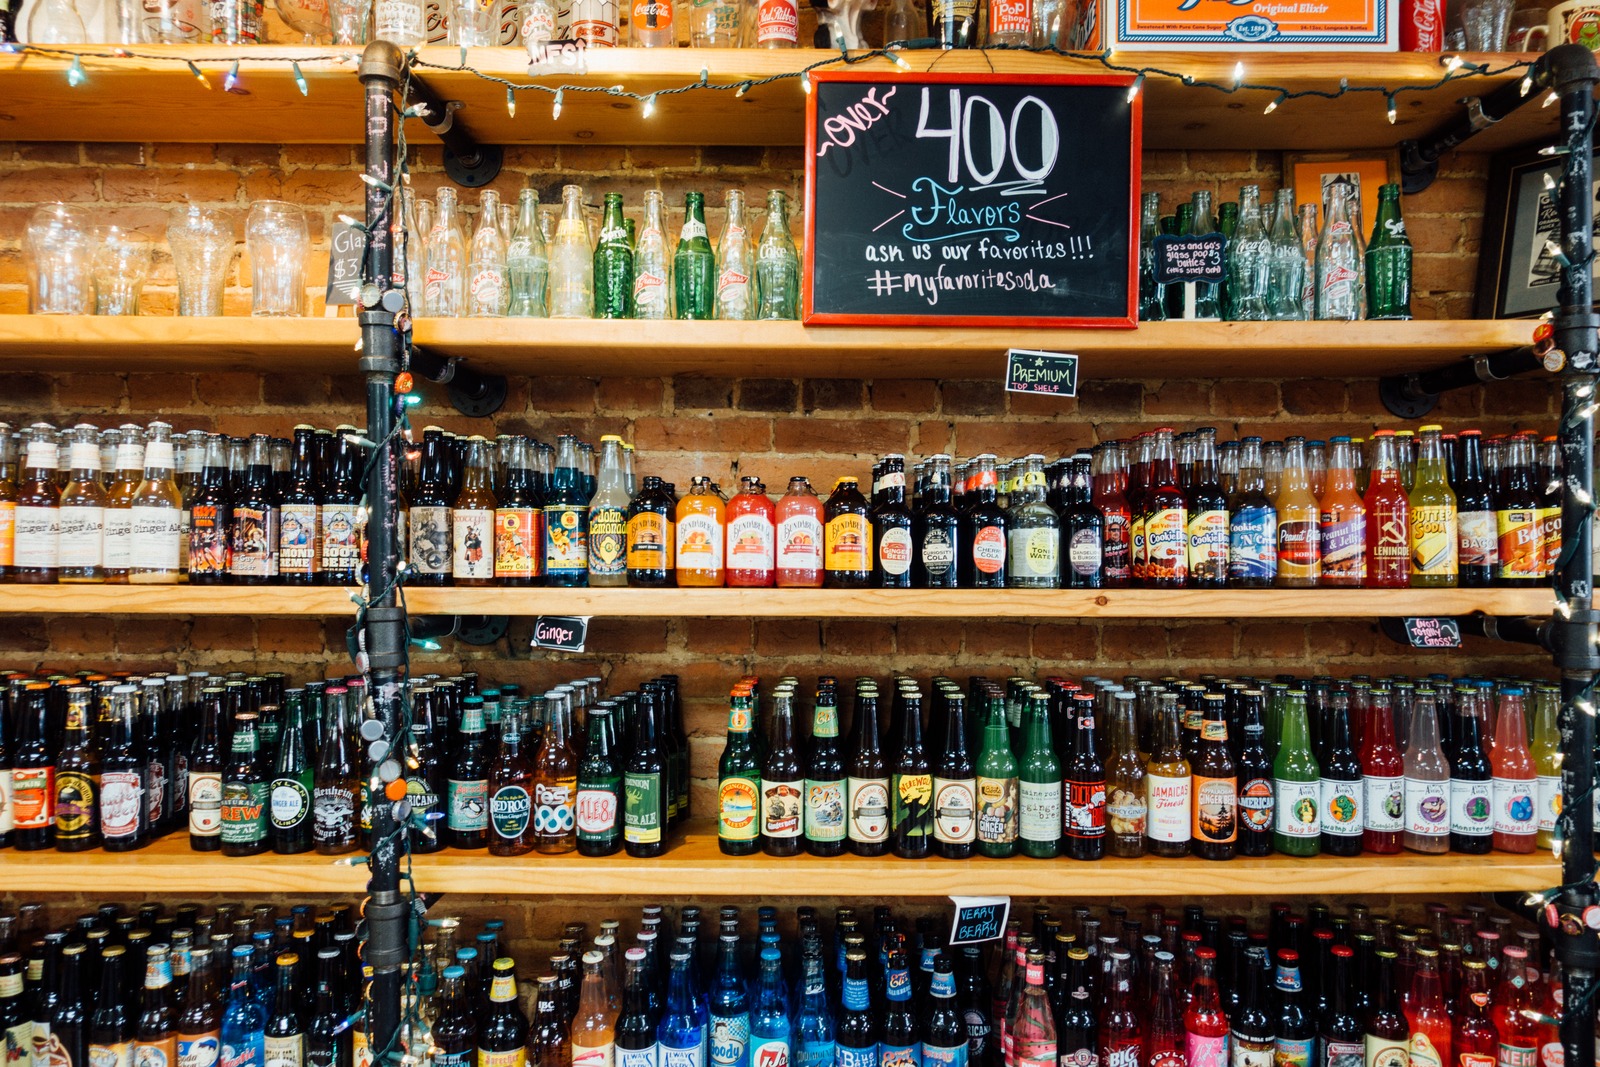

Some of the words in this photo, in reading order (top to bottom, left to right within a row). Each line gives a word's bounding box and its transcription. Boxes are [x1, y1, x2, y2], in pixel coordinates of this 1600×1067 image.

[633, 2, 670, 17] Coca-Cola
[1252, 4, 1298, 15] Original
[1299, 3, 1329, 13] Elixir
[915, 87, 1060, 184] 400
[911, 177, 1021, 225] Flavors
[600, 227, 627, 243] Sprite
[760, 244, 787, 260] Coke
[865, 242, 904, 262] ask
[912, 243, 932, 261] us
[942, 245, 970, 261] our
[979, 236, 1094, 261] favorites!!!
[1166, 243, 1186, 251] 50's
[1203, 242, 1220, 250] 60's
[1166, 251, 1190, 262] glass
[1192, 250, 1208, 260] pop
[1012, 362, 1072, 387] PREMIUM
[1011, 382, 1028, 390] TOP
[597, 509, 622, 523] John
[1411, 509, 1453, 525] BUTTER
[49, 522, 60, 532] Al
[86, 522, 103, 531] Ale
[105, 527, 131, 536] Ginge
[134, 524, 167, 534] Ginger
[169, 523, 181, 532] Ale
[1415, 522, 1447, 539] SODA
[1280, 529, 1306, 543] Peanut
[1322, 525, 1350, 542] Peanut
[1329, 540, 1337, 549] &
[322, 547, 360, 558] ROOT
[1373, 546, 1410, 556] LENINADE
[322, 558, 359, 568] BEER
[515, 562, 530, 570] Cola
[1416, 618, 1439, 629] (NOT)
[536, 622, 573, 644] Ginger
[1155, 797, 1185, 810] Finest
[1288, 824, 1304, 834] Bug
[1413, 823, 1430, 833] Dog
[1494, 822, 1524, 833] Fungal
[961, 906, 995, 924] VERRY
[959, 921, 998, 939] BERRY
[1026, 969, 1042, 977] DRY
[538, 1000, 555, 1009] IBC
[1499, 1047, 1537, 1066] NEHI
